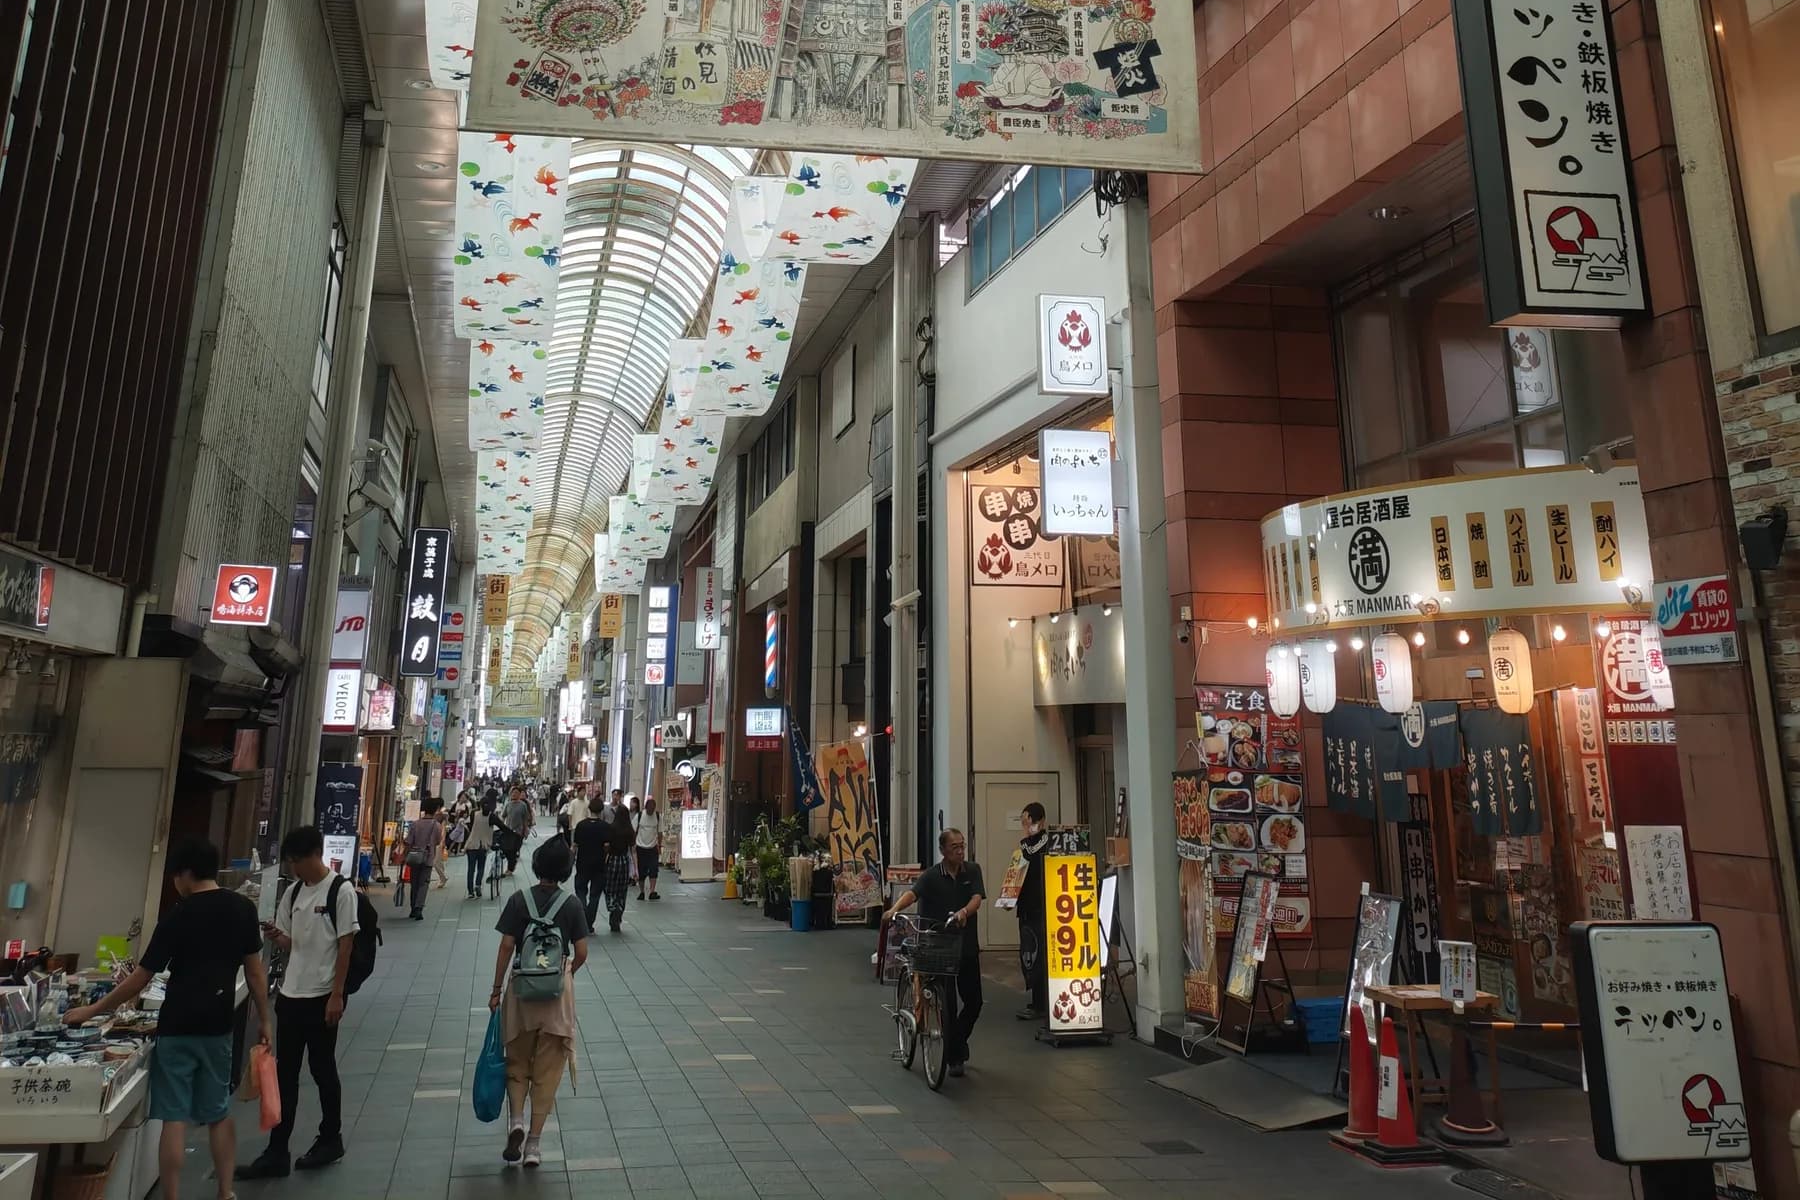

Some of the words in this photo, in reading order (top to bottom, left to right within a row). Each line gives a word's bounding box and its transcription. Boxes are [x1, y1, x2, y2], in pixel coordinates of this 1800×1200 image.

[1059, 360, 1094, 373] 鳥メロ
[1052, 503, 1109, 518] いっちゃん
[1325, 495, 1411, 530] 屋台居酒屋
[1434, 527, 1453, 581] 日本酒
[1470, 523, 1489, 579] 焼酎
[1508, 512, 1530, 584] ハイボール
[1550, 509, 1574, 583] 生ビール
[1595, 515, 1618, 568] 酎ハイ
[1015, 561, 1058, 578] 鳥メロ
[1350, 530, 1387, 589] 満
[1334, 599, 1355, 617] 大阪
[1356, 594, 1418, 615] MANMAR
[1696, 589, 1728, 607] 賃貸の
[335, 615, 365, 634] JTB
[701, 597, 717, 647] まるしげ
[1690, 609, 1730, 631] エリッツ
[333, 682, 350, 721] VELOCE
[1224, 689, 1266, 711] 定食
[1052, 831, 1080, 852] 2階
[1055, 863, 1077, 972] 199円
[1073, 862, 1098, 972] 生ビール
[1607, 979, 1719, 995] お好み焼き・鉄板焼き
[1614, 1004, 1723, 1039] テッペン。
[11, 1078, 72, 1095] 子供茶碗
